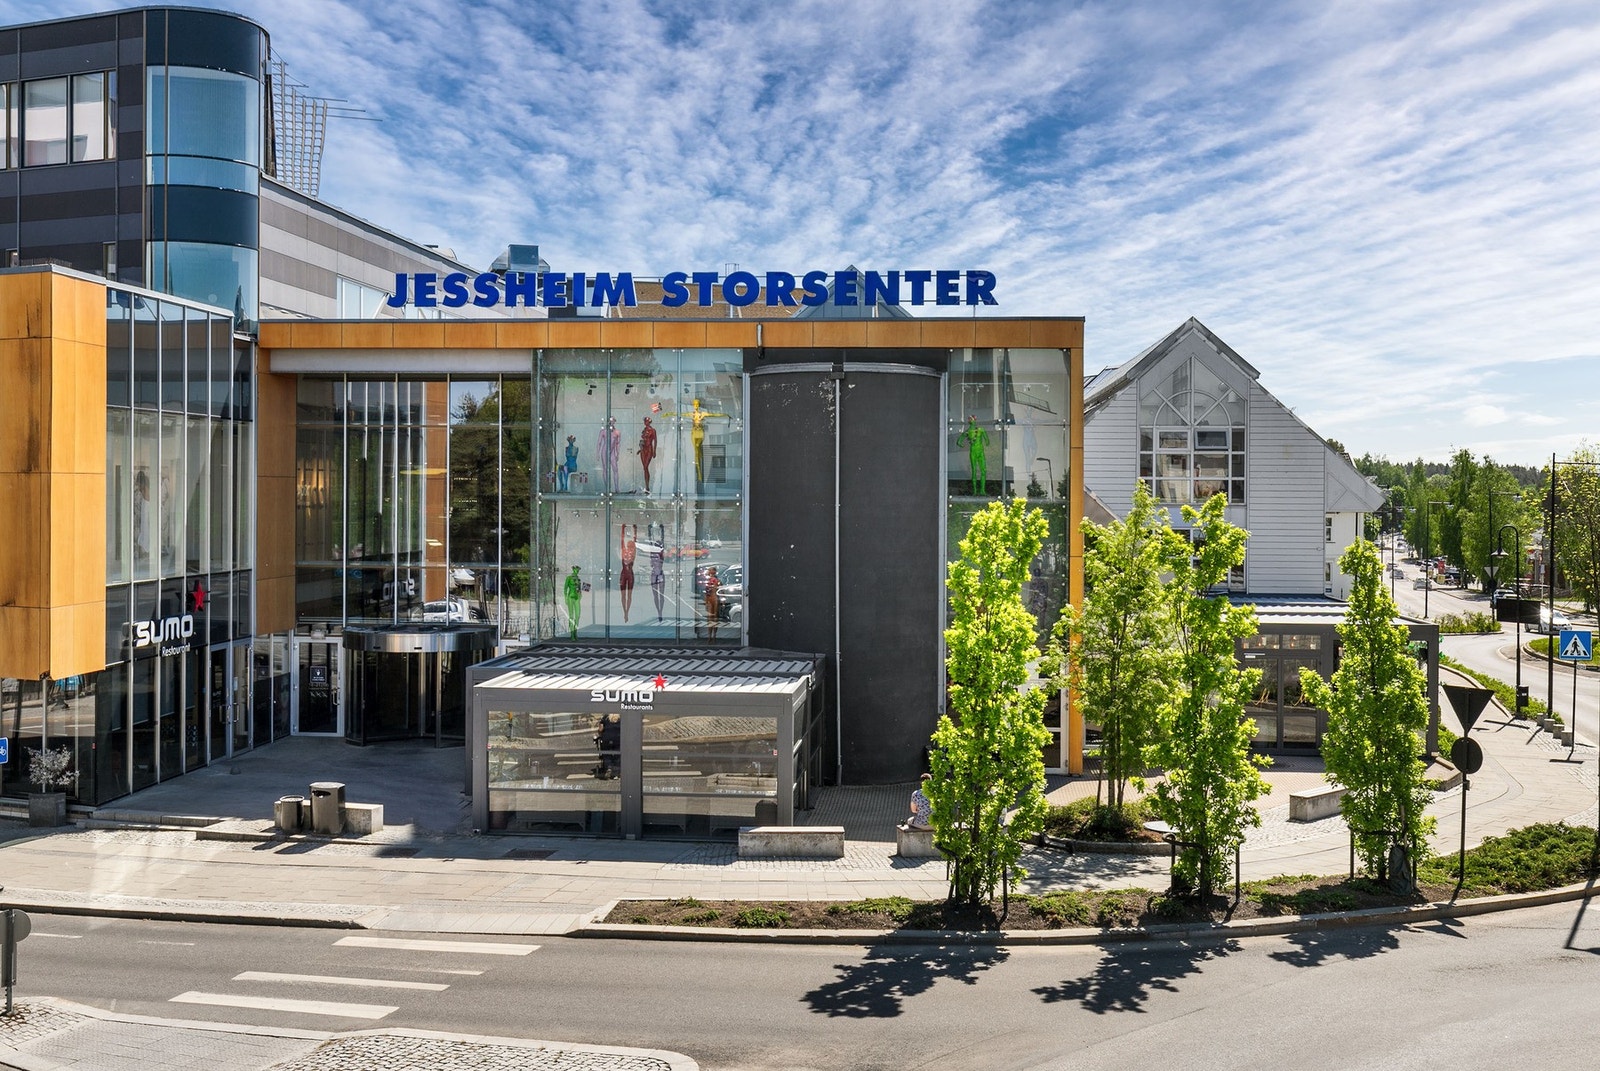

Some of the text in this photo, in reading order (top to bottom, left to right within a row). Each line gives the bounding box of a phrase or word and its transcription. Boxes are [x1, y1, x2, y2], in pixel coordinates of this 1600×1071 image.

[387, 270, 999, 308] JESSHEIM STORSENTER
[133, 614, 194, 648] SUMO
[590, 689, 654, 703] SUMO
[620, 703, 654, 711] Restaurants
